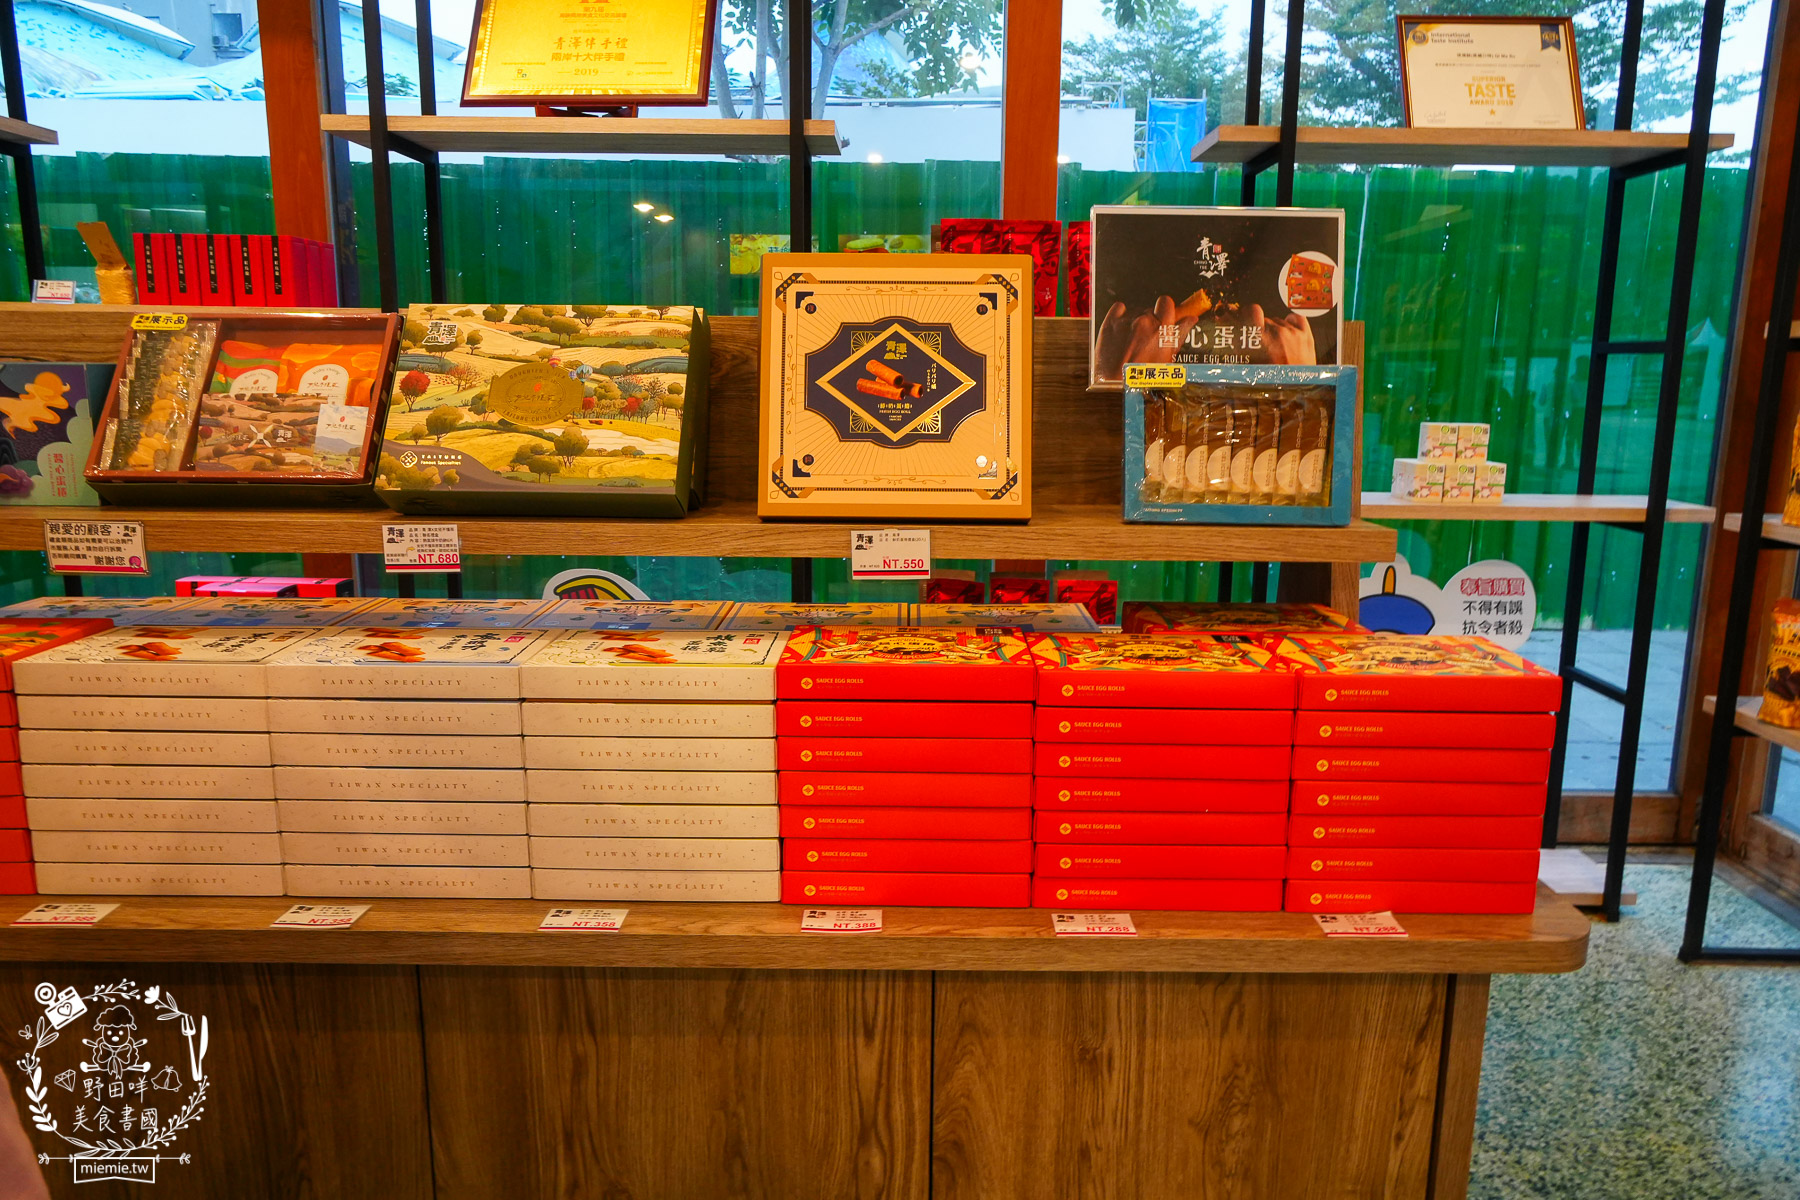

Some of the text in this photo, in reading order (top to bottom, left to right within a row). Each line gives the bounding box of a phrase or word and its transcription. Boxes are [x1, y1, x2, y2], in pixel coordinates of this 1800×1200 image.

[553, 36, 629, 50] 青澤伴手禮
[574, 68, 599, 76] 2019
[1464, 83, 1517, 98] TASTE
[1197, 237, 1230, 277] 青澤
[151, 315, 184, 324] 展示品
[428, 321, 457, 337] 青澤
[1158, 325, 1262, 350] 醬心蛋捲
[1171, 354, 1250, 364] SAUCE EGG ROLLS
[1145, 368, 1183, 379] 展示品
[94, 556, 126, 566] 謝謝您
[418, 553, 459, 564] NT.680
[883, 559, 924, 569] NT.550
[1460, 578, 1525, 596] 奉旨購買
[1463, 601, 1523, 616] 不得有誤
[1462, 620, 1523, 635] 抗令者殺
